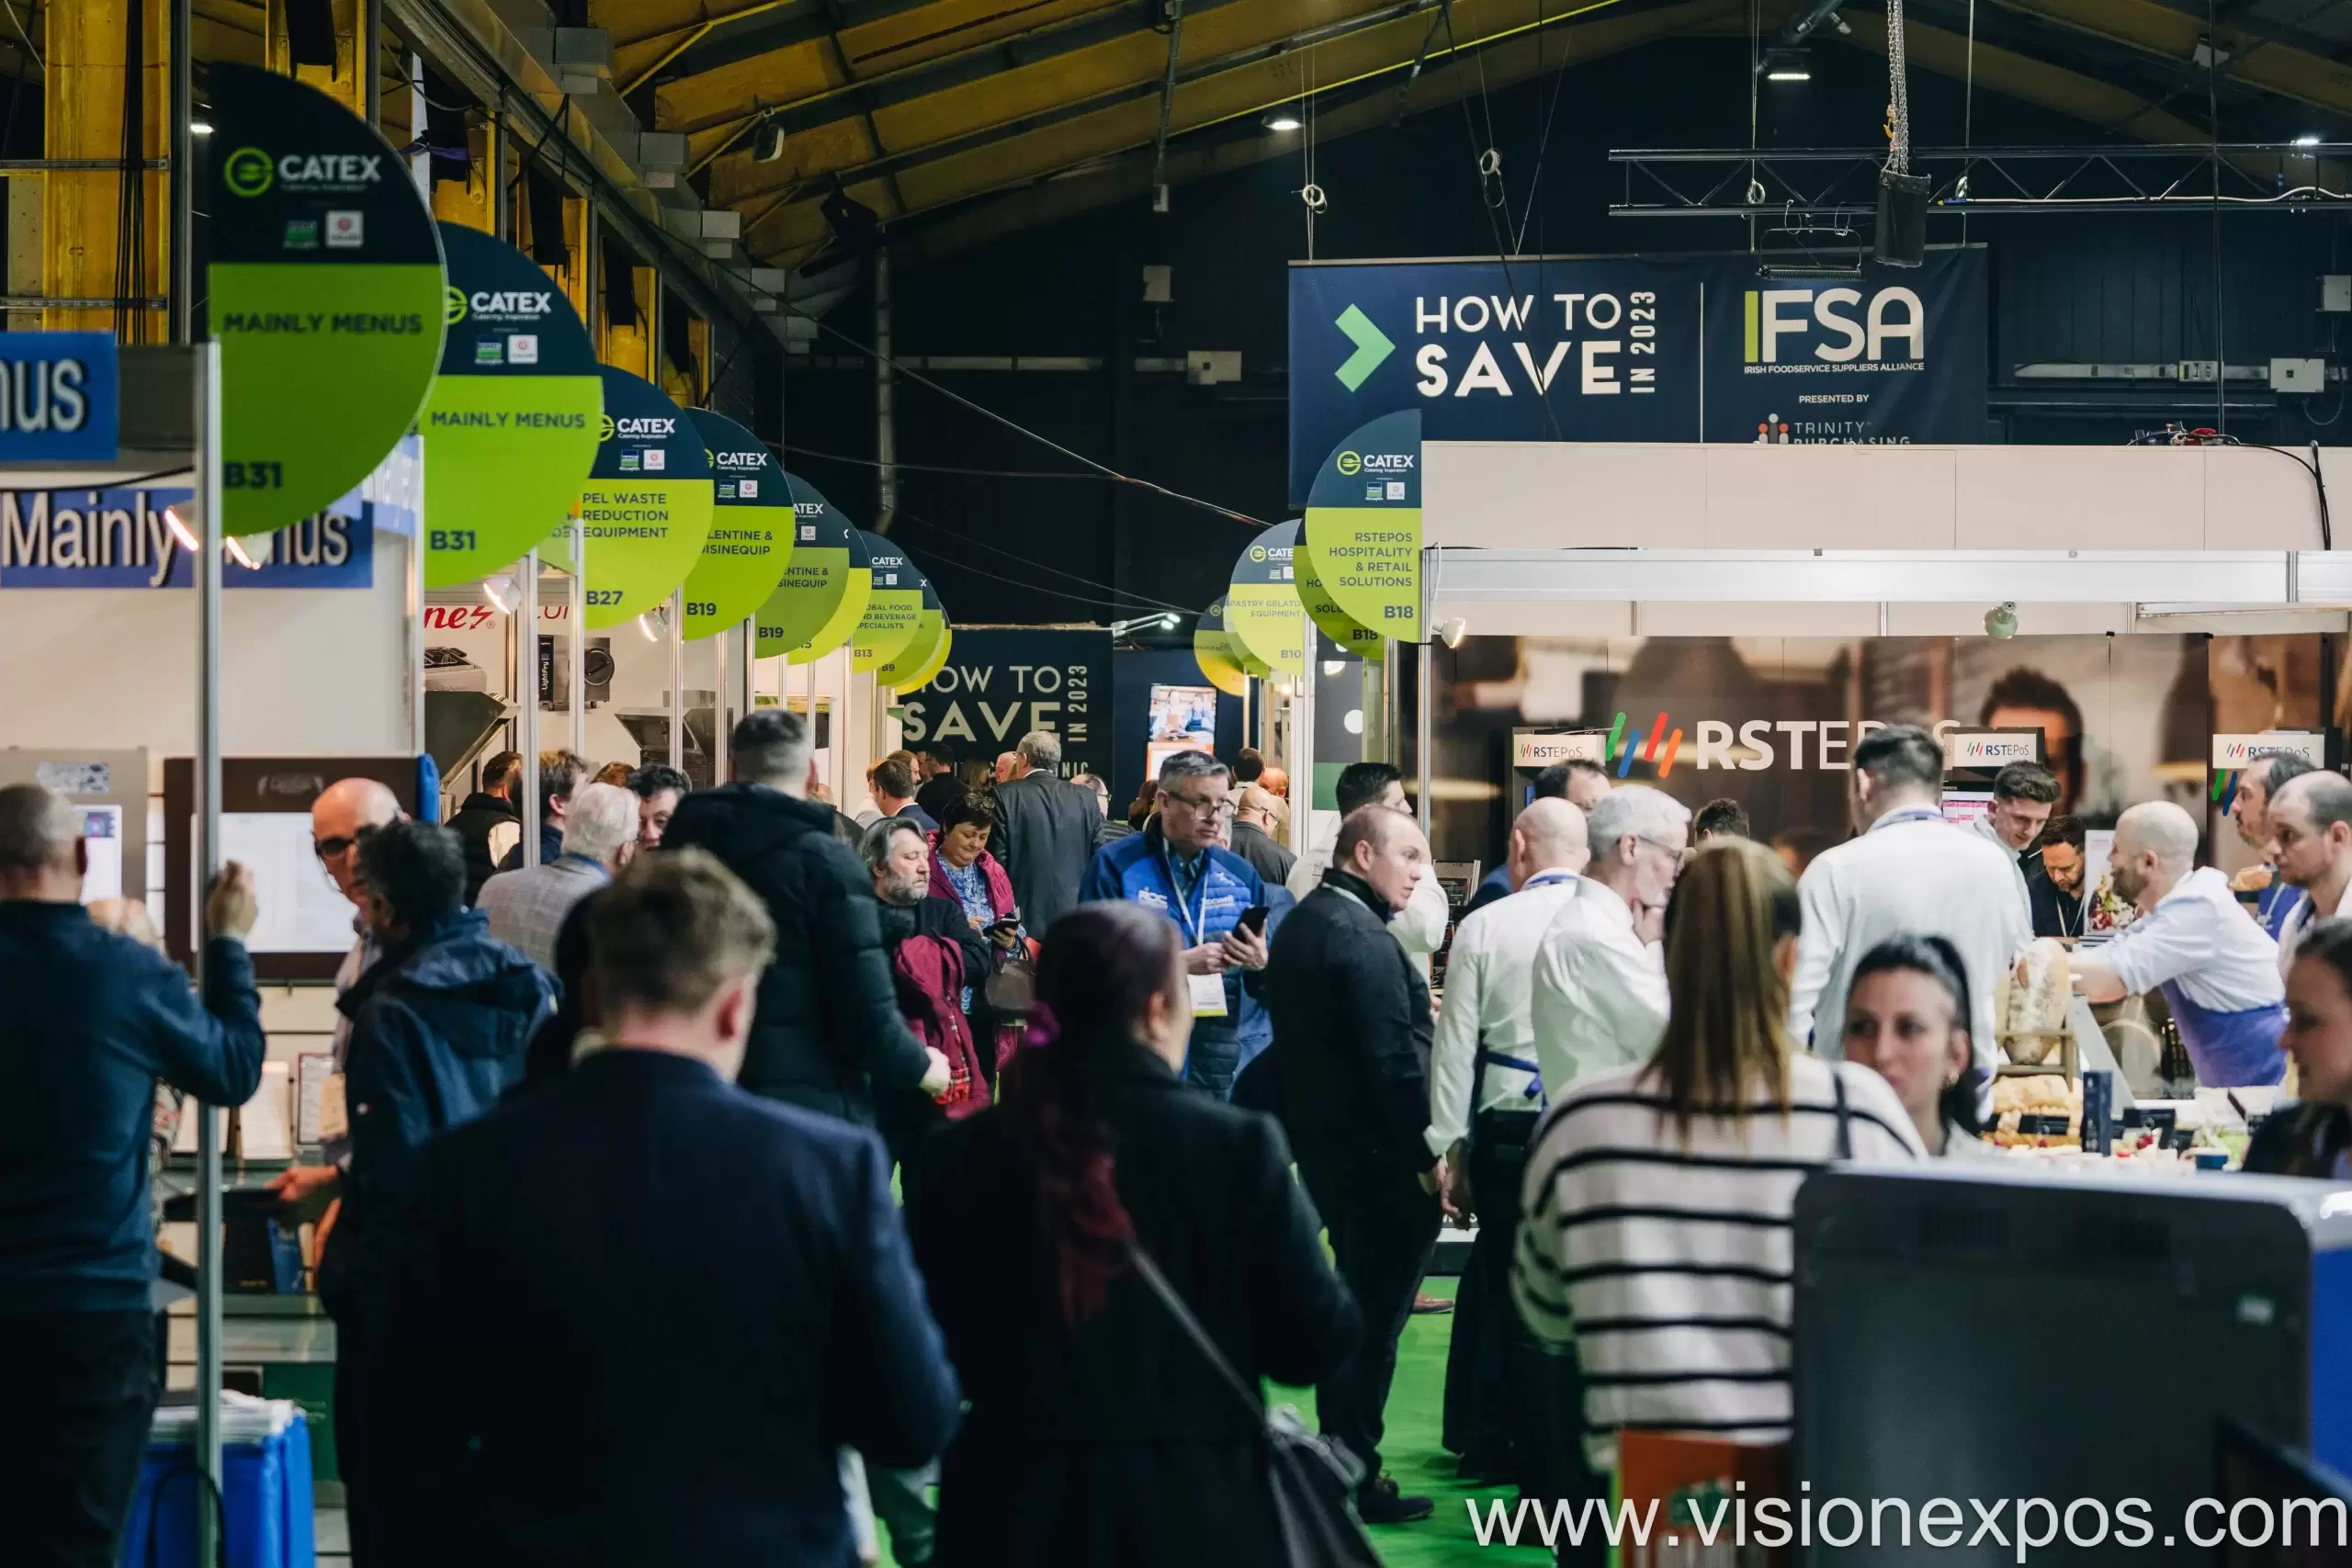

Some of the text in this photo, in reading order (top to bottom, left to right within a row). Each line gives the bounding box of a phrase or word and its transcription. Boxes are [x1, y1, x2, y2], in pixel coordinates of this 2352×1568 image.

[278, 154, 381, 182] CATEX
[470, 291, 551, 313] CATEX
[1416, 292, 1622, 334] HOW TO
[223, 312, 424, 334] MAINLY MENUS
[1744, 287, 1925, 363] IFSA
[1630, 290, 1656, 393] IN 2023
[1416, 340, 1622, 398] SAVE
[1744, 362, 1925, 375] IRISH FOODSERVICE SUPPLIERS ALLIANCE
[1799, 394, 1870, 403] PRESENTED BY
[432, 412, 586, 428] MAINLY MENUS
[616, 418, 675, 434] CATEX
[1794, 421, 1865, 434] TRINITY
[717, 452, 767, 466] CATEX
[1363, 454, 1415, 468] CATEX
[224, 461, 281, 489] B31
[582, 493, 667, 504] PEL WASTE
[794, 502, 824, 514] ATEX
[582, 510, 669, 521] REDUCTION
[583, 526, 669, 538] EQUIPMENT
[764, 531, 773, 540] &
[1355, 532, 1412, 542] RSTEPOS
[2, 490, 176, 588] Mainly
[430, 530, 476, 550] B31
[701, 545, 771, 556] ISINEQUIP
[1268, 547, 1294, 558] CATE
[1329, 547, 1412, 557] HOSPITALITY
[872, 557, 902, 566] CATEX
[1355, 561, 1412, 572] & RETAIL
[821, 568, 829, 576] &
[1340, 577, 1412, 587] SOLUTIONS
[586, 591, 623, 605] B27
[686, 603, 717, 615] B19
[1385, 605, 1414, 618] B18
[758, 626, 784, 638] B19
[1352, 628, 1379, 640] B18
[854, 649, 873, 658] B13
[1281, 649, 1302, 659] B10
[922, 665, 1061, 694] OW TO
[1068, 665, 1088, 742] IN 2023
[903, 700, 1061, 742] SAVE
